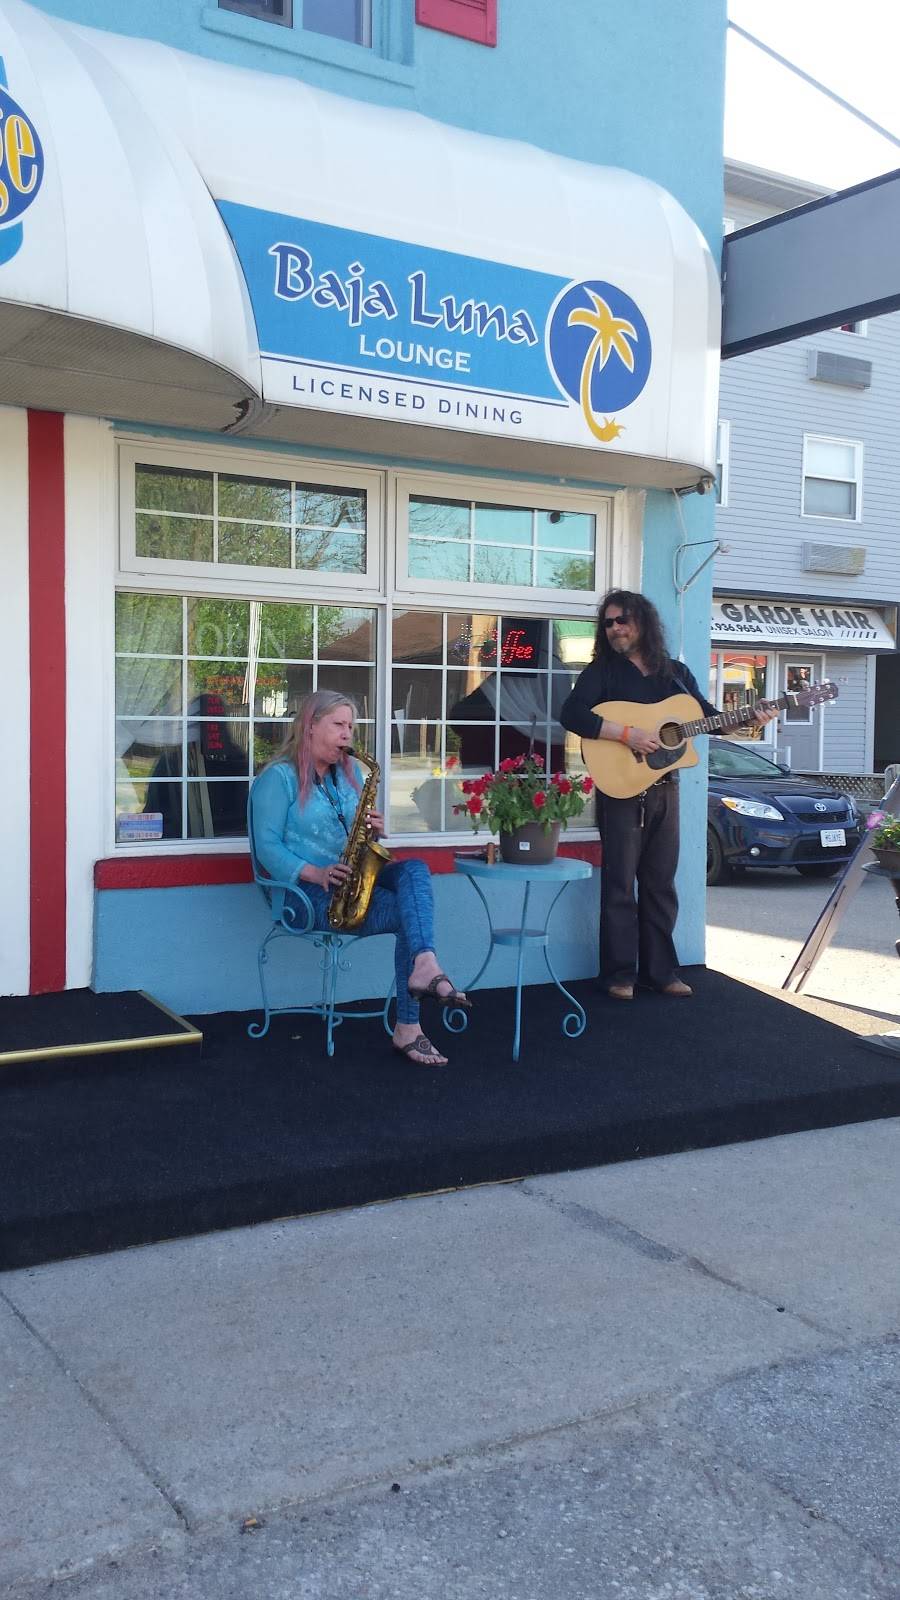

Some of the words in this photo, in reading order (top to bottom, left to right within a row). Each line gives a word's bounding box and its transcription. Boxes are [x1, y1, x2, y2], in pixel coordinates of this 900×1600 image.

[267, 242, 398, 327] Baja
[407, 271, 539, 346] Luna
[359, 334, 472, 373] LOUNGE
[292, 376, 425, 410] LICENSED
[439, 399, 523, 425] DINING
[720, 603, 809, 626] GARDE
[810, 608, 875, 630] HAIR
[765, 625, 801, 636] UNISEX
[801, 628, 834, 638] SALON
